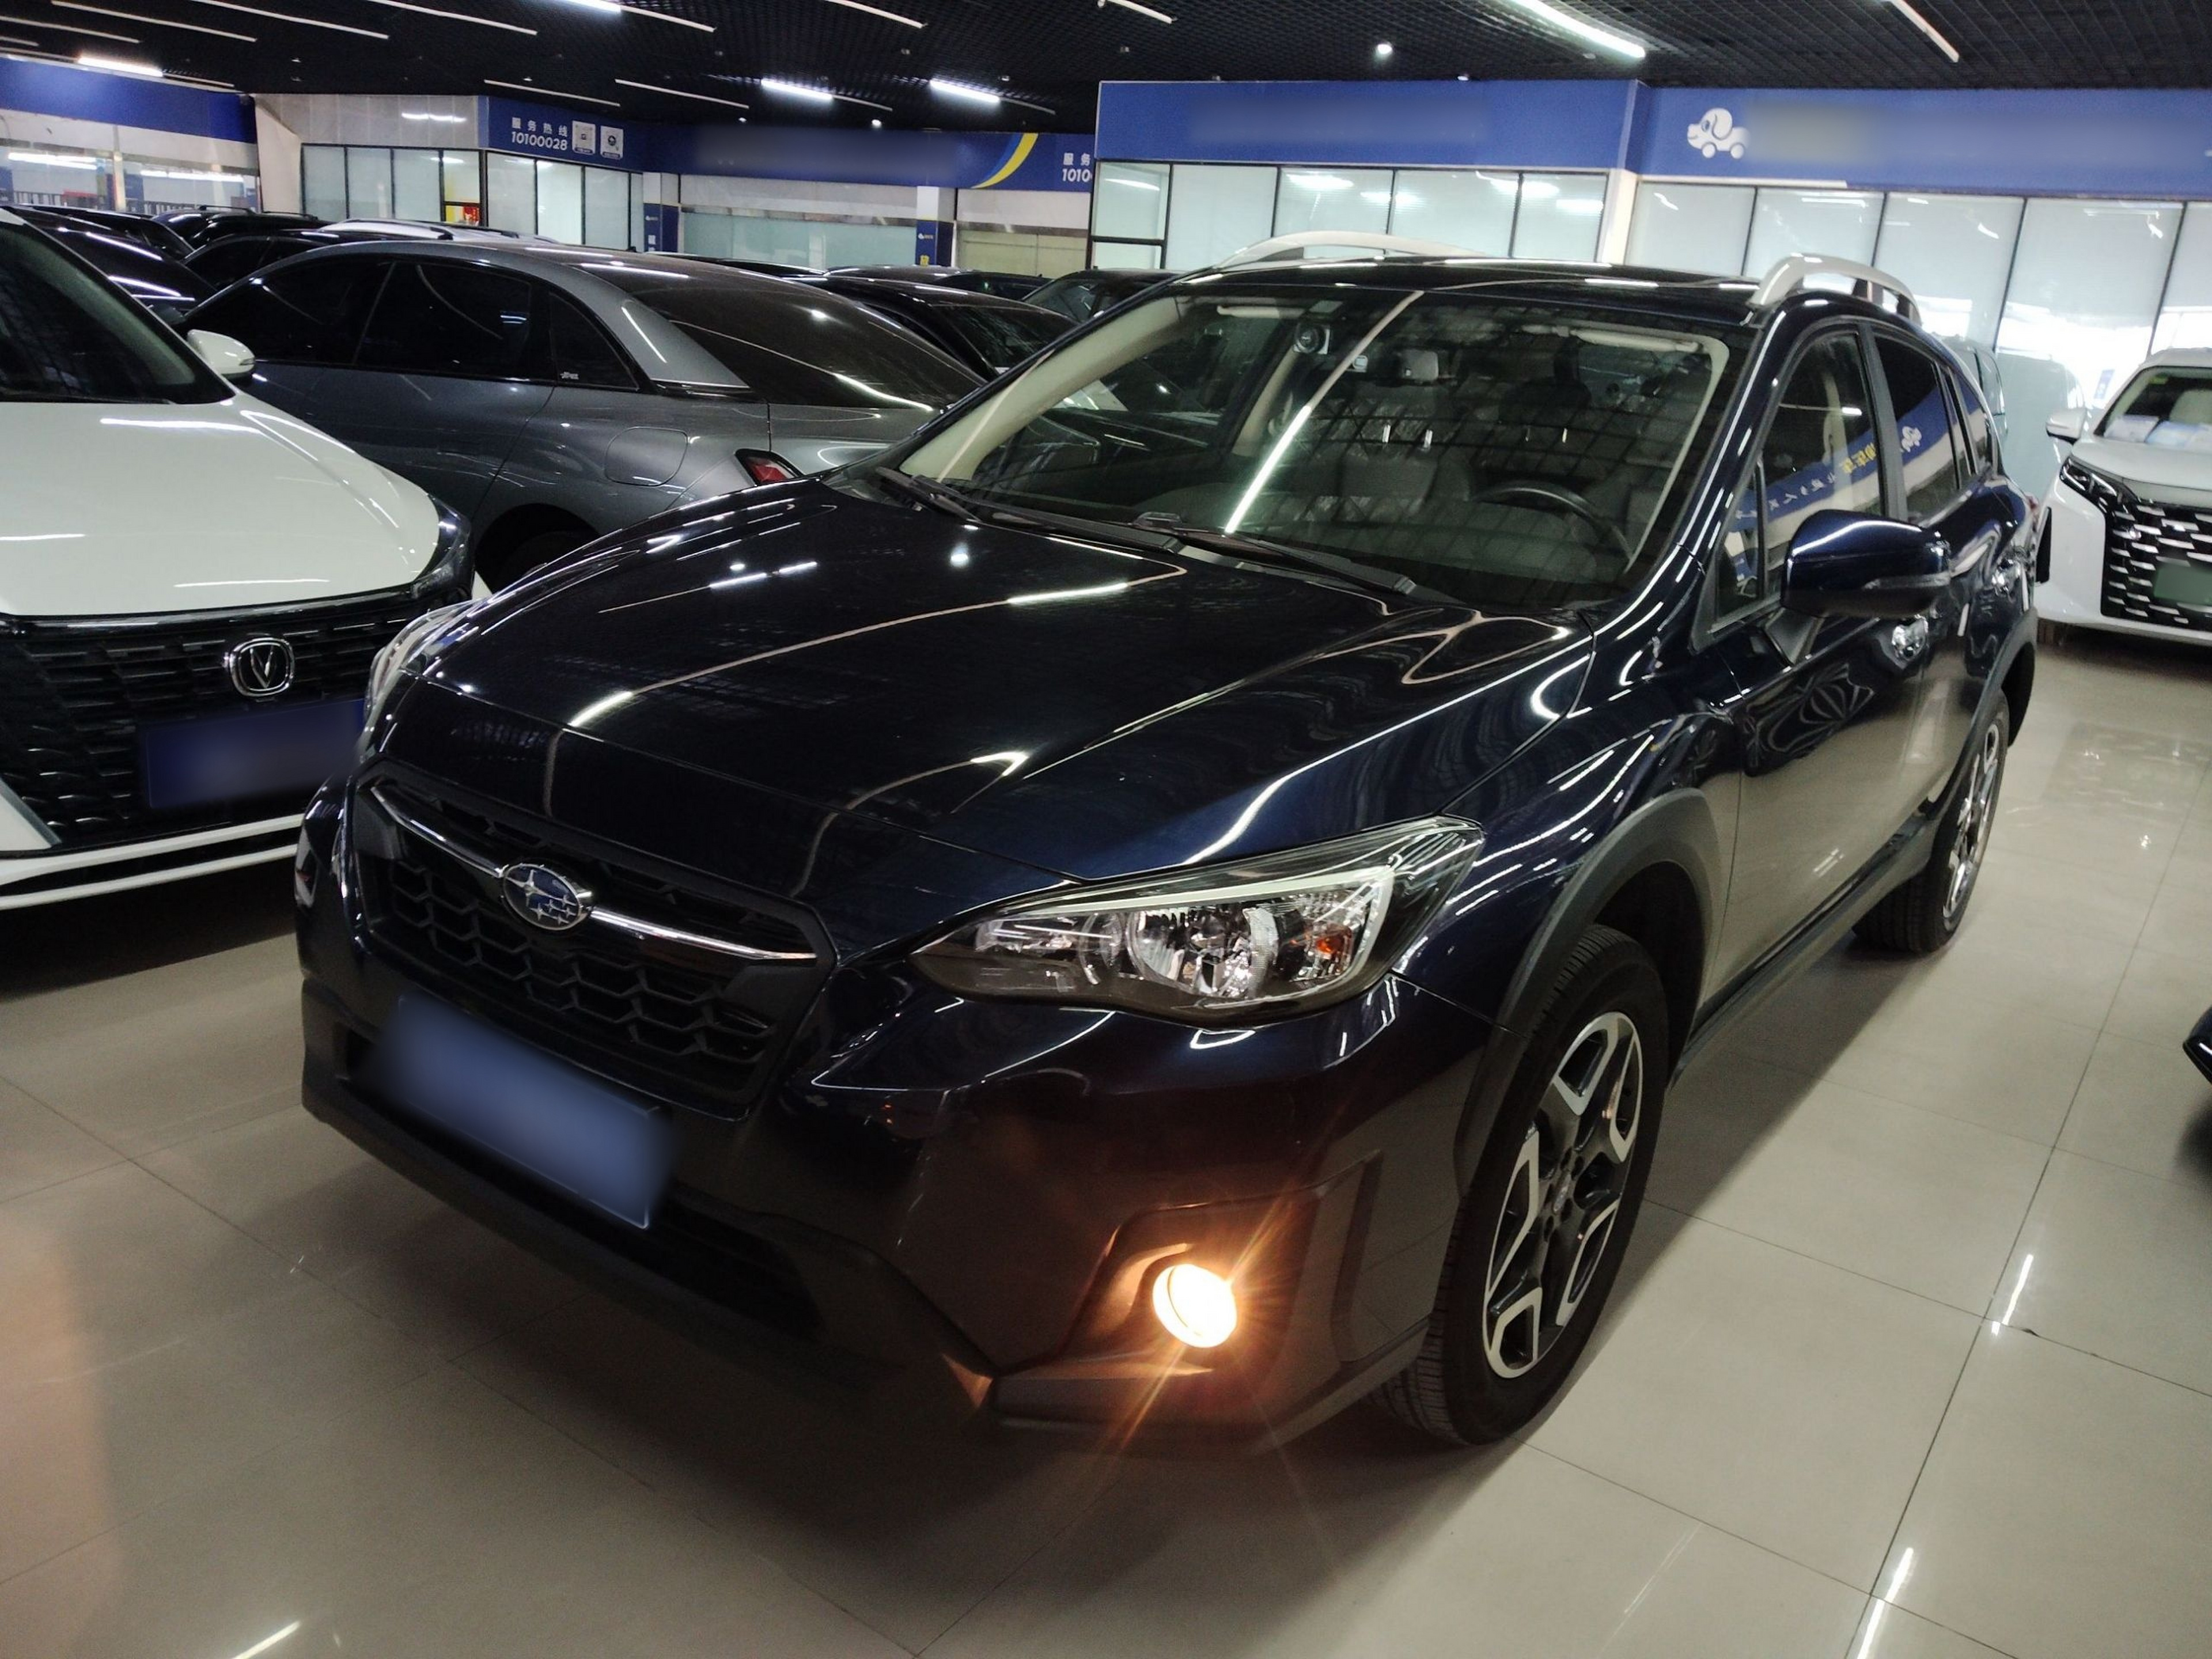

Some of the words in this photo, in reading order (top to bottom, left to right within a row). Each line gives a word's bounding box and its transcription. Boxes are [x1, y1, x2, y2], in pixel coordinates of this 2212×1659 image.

[512, 117, 567, 137] 服务热线
[512, 131, 567, 151] 10100028
[1062, 168, 1093, 183] 1010
